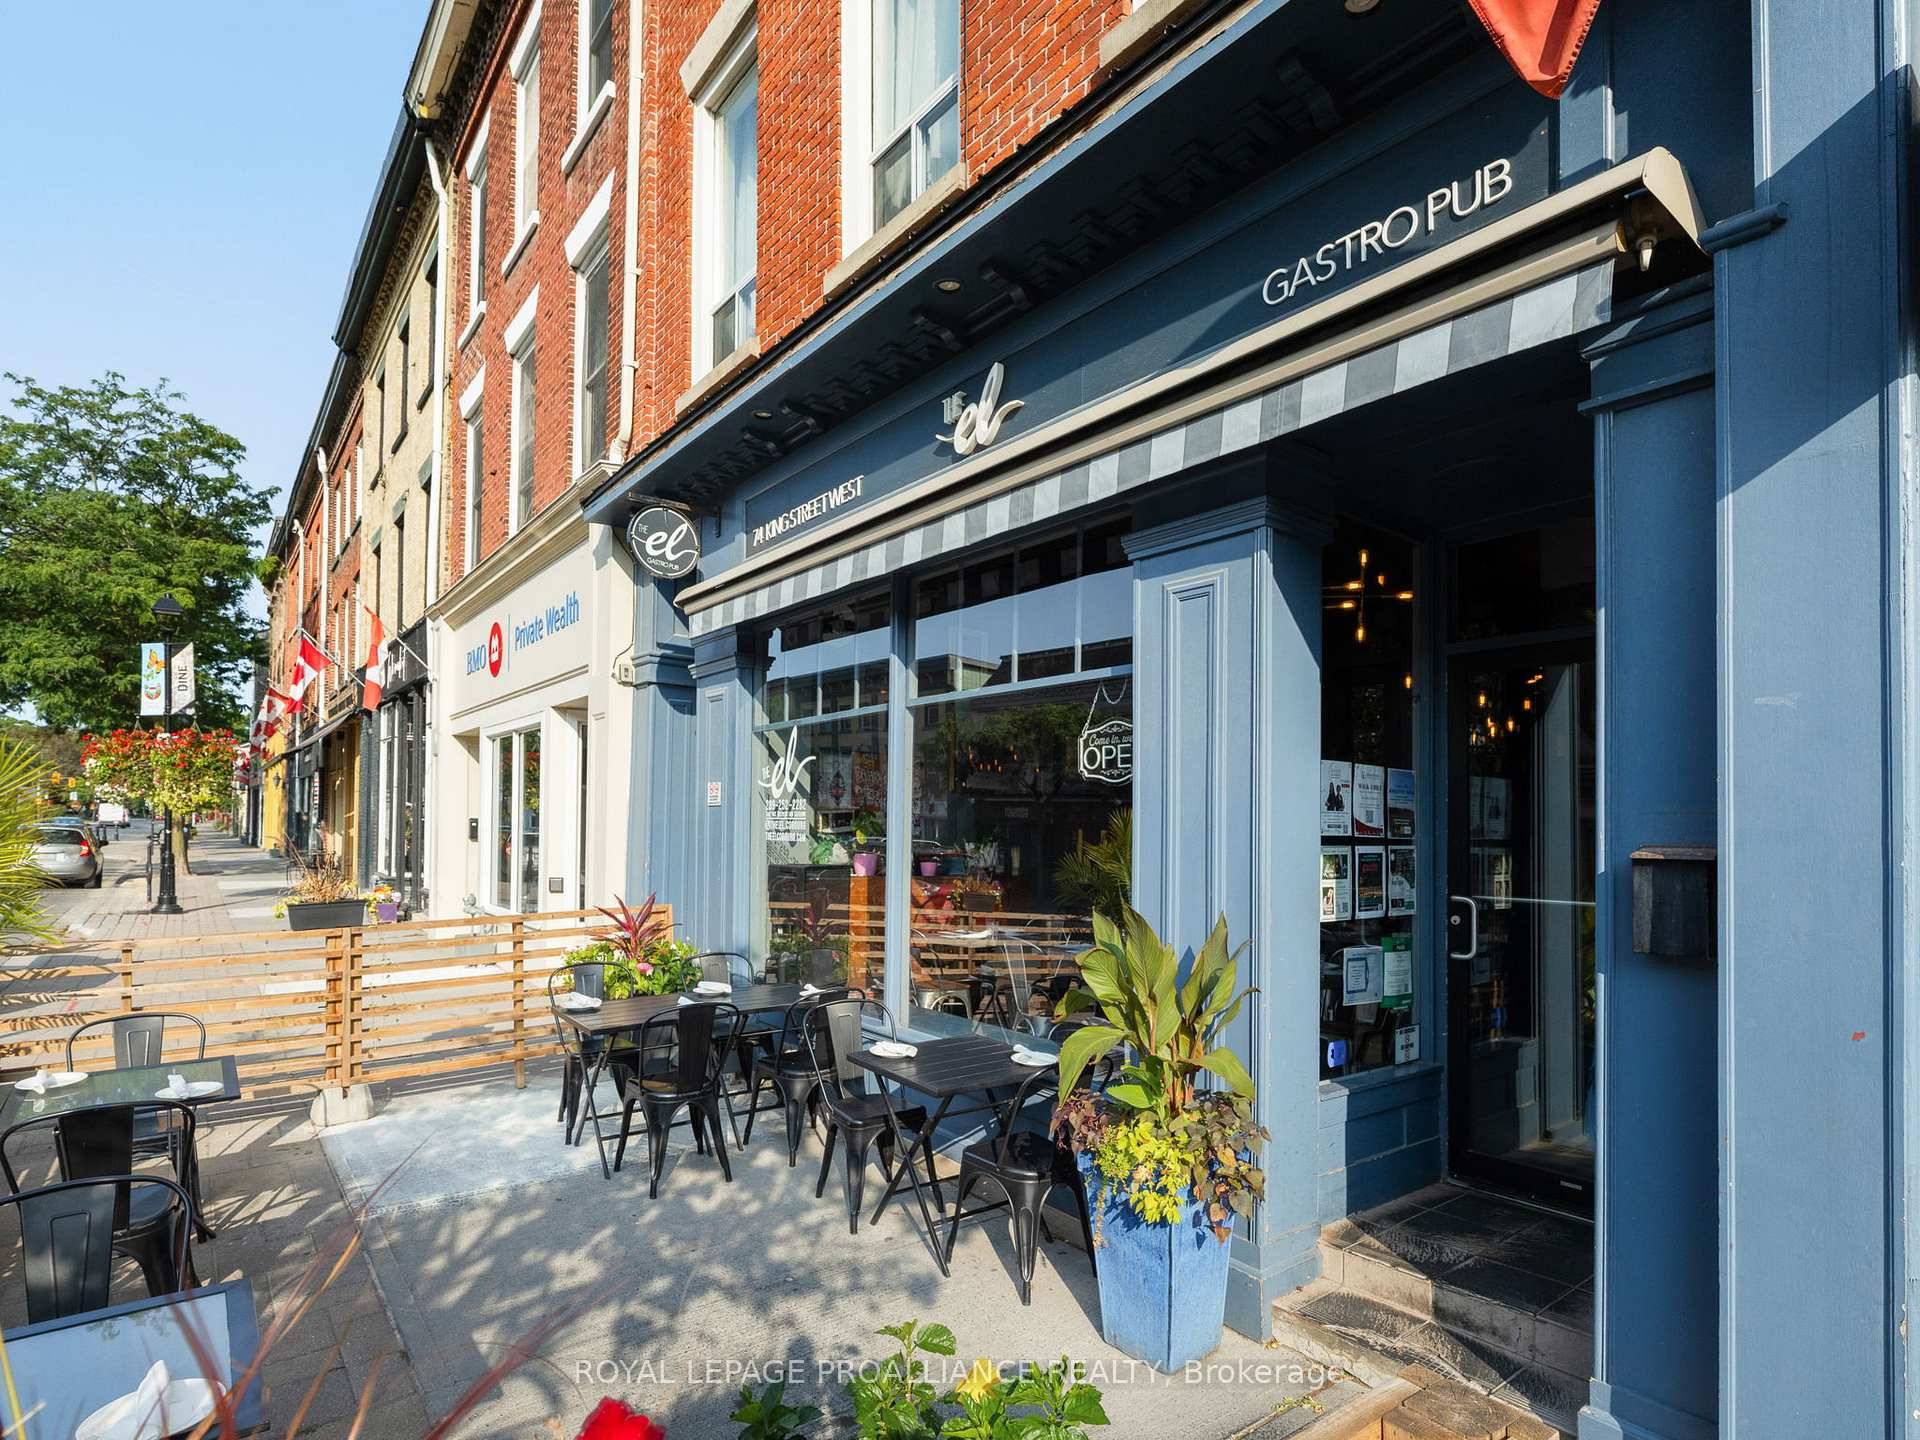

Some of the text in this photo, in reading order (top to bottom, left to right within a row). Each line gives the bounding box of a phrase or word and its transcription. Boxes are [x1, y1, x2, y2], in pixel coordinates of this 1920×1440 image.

[1262, 158, 1512, 305] GASTRO PUB
[752, 474, 865, 547] 74 KING STREET WEST
[633, 522, 698, 561] el
[638, 523, 649, 535] THE
[646, 556, 680, 571] GASTRO PUB
[514, 591, 580, 651] Private Wealth
[466, 644, 487, 676] BMO
[177, 665, 189, 692] DINE
[1089, 734, 1110, 746] Come
[1083, 744, 1131, 769] OPE
